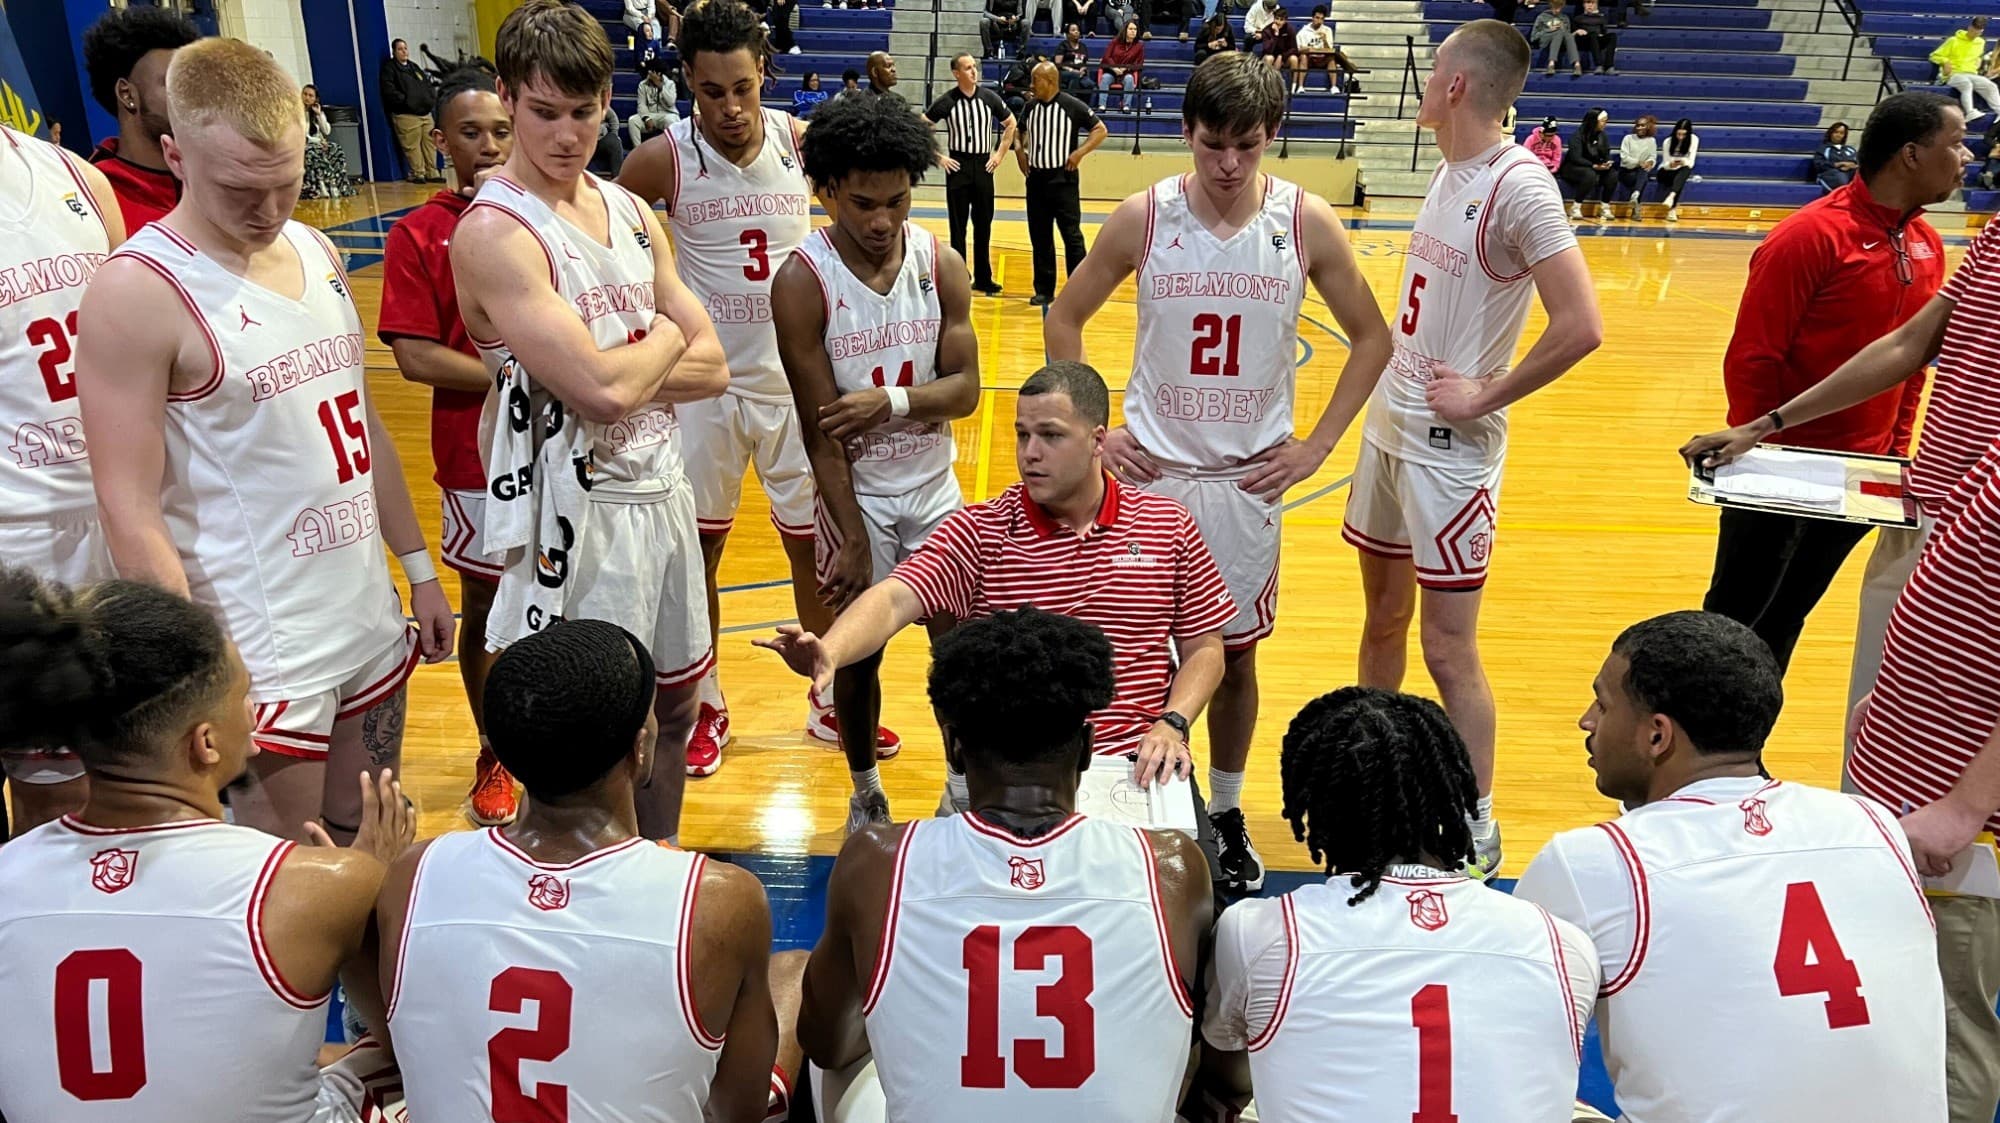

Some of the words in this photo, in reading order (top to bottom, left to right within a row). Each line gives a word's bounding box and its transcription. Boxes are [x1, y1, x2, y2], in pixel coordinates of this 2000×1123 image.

[687, 193, 807, 226] BELMONT
[739, 228, 771, 281] 3
[1151, 272, 1290, 304] BELMONT
[705, 292, 773, 325] ABB
[1400, 271, 1428, 337] 5
[25, 309, 79, 403] 2
[246, 332, 365, 403] BELMON
[830, 318, 943, 361] BELMONT
[1189, 312, 1242, 377] 21
[317, 388, 372, 485] 15
[1155, 382, 1276, 424] ABBEY
[491, 461, 534, 502] GA
[286, 489, 377, 559] ABB
[1772, 880, 1870, 1030] 4
[54, 947, 147, 1101] 0
[960, 924, 1095, 1089] 13
[487, 965, 573, 1123] 2
[1410, 983, 1459, 1123] 1
